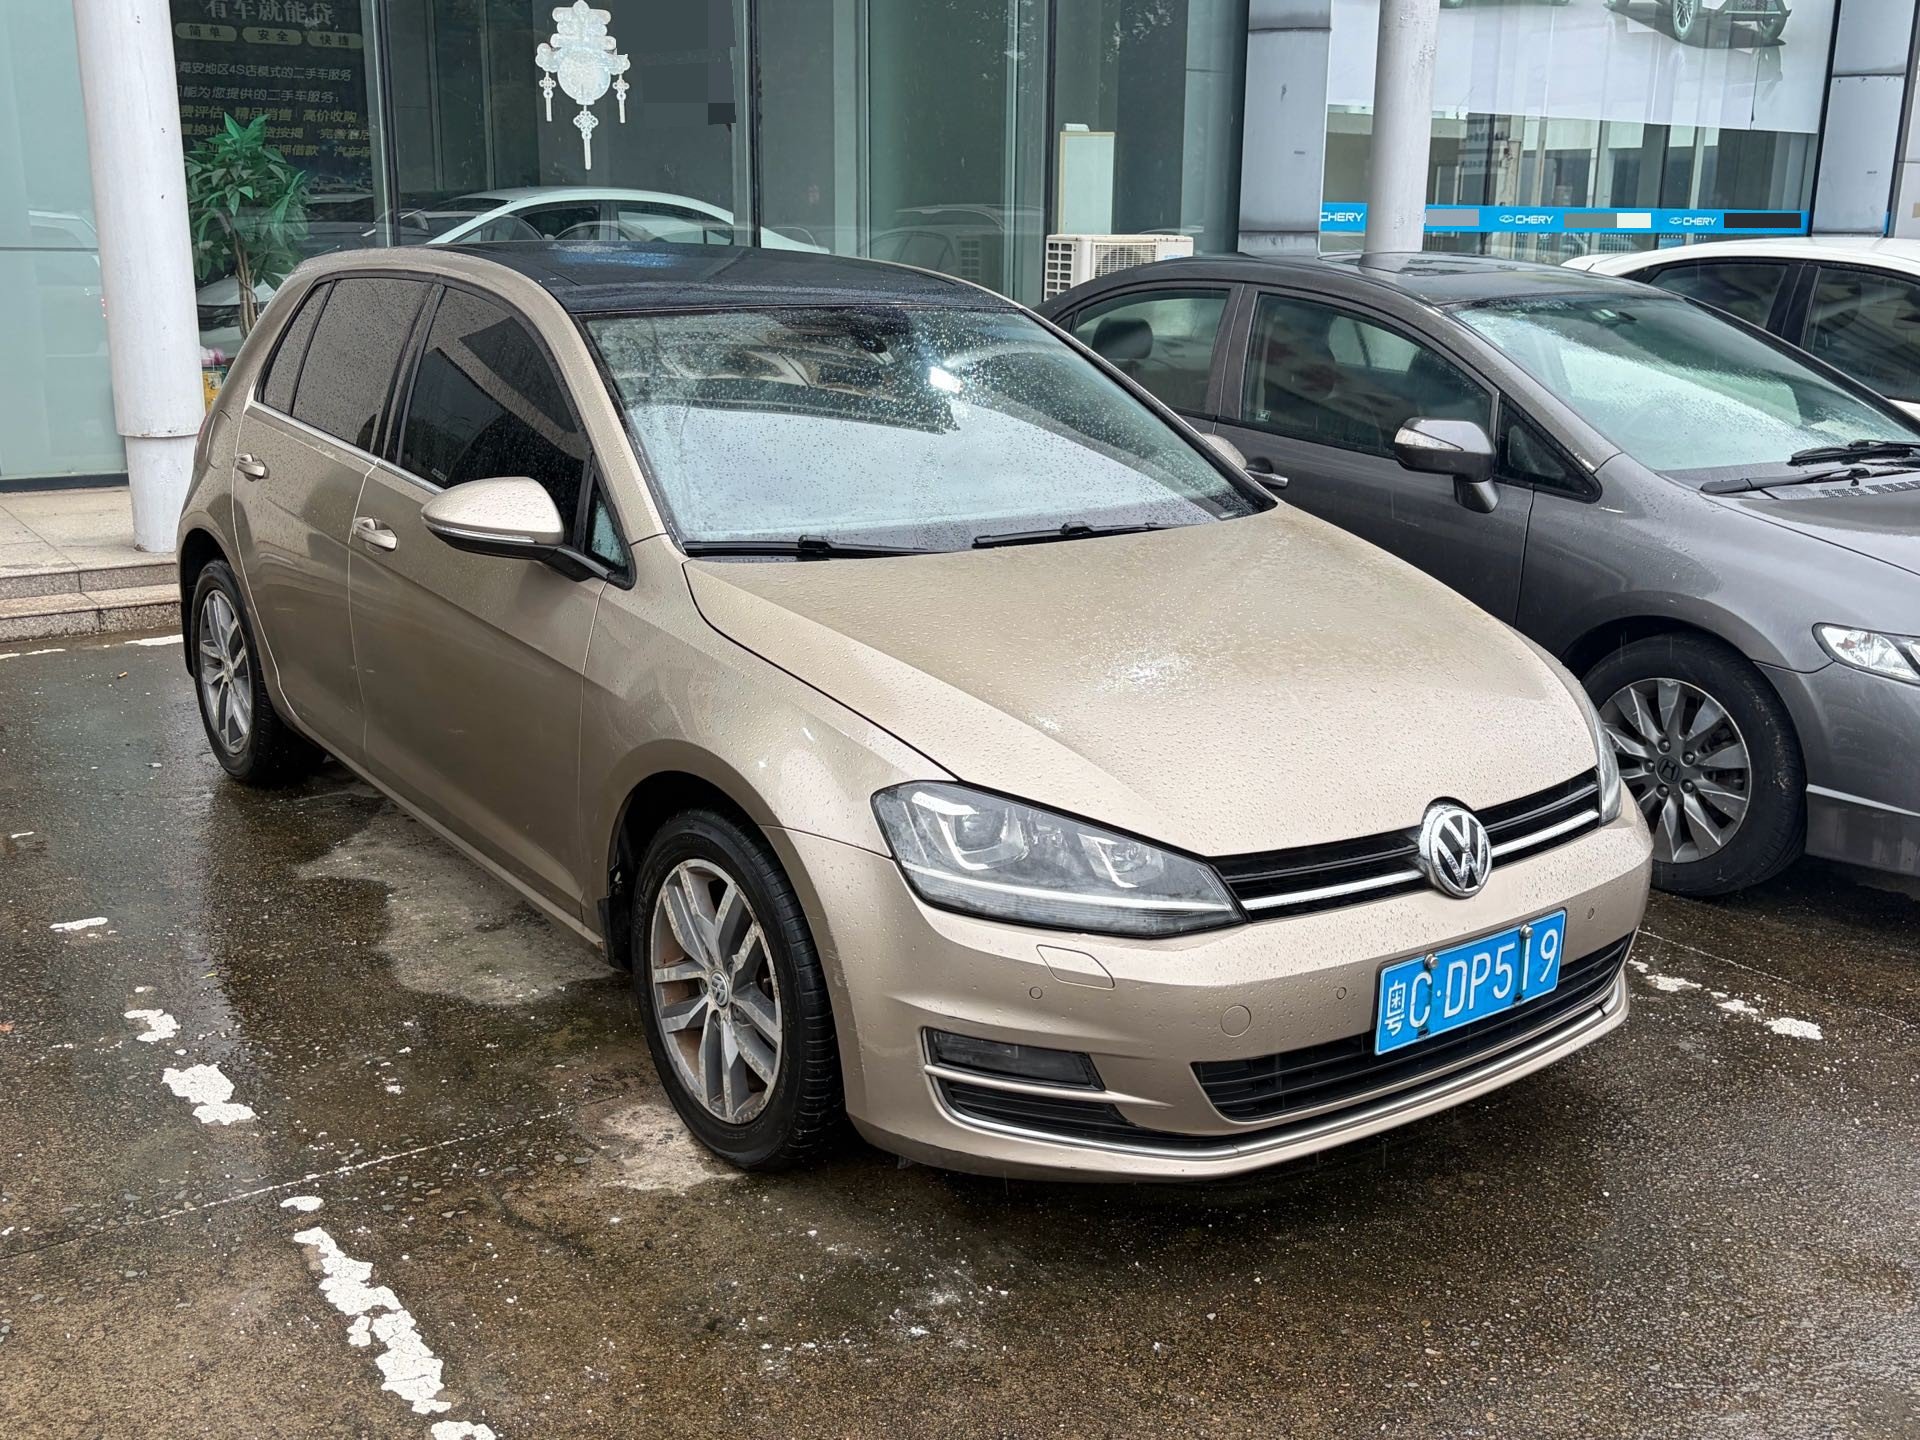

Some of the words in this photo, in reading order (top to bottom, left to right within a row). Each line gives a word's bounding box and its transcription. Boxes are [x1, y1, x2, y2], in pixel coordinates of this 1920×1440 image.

[257, 30, 290, 42] 安全
[1320, 211, 1364, 222] CHERY
[1515, 214, 1554, 225] CHERY
[1682, 216, 1717, 226] CHERY
